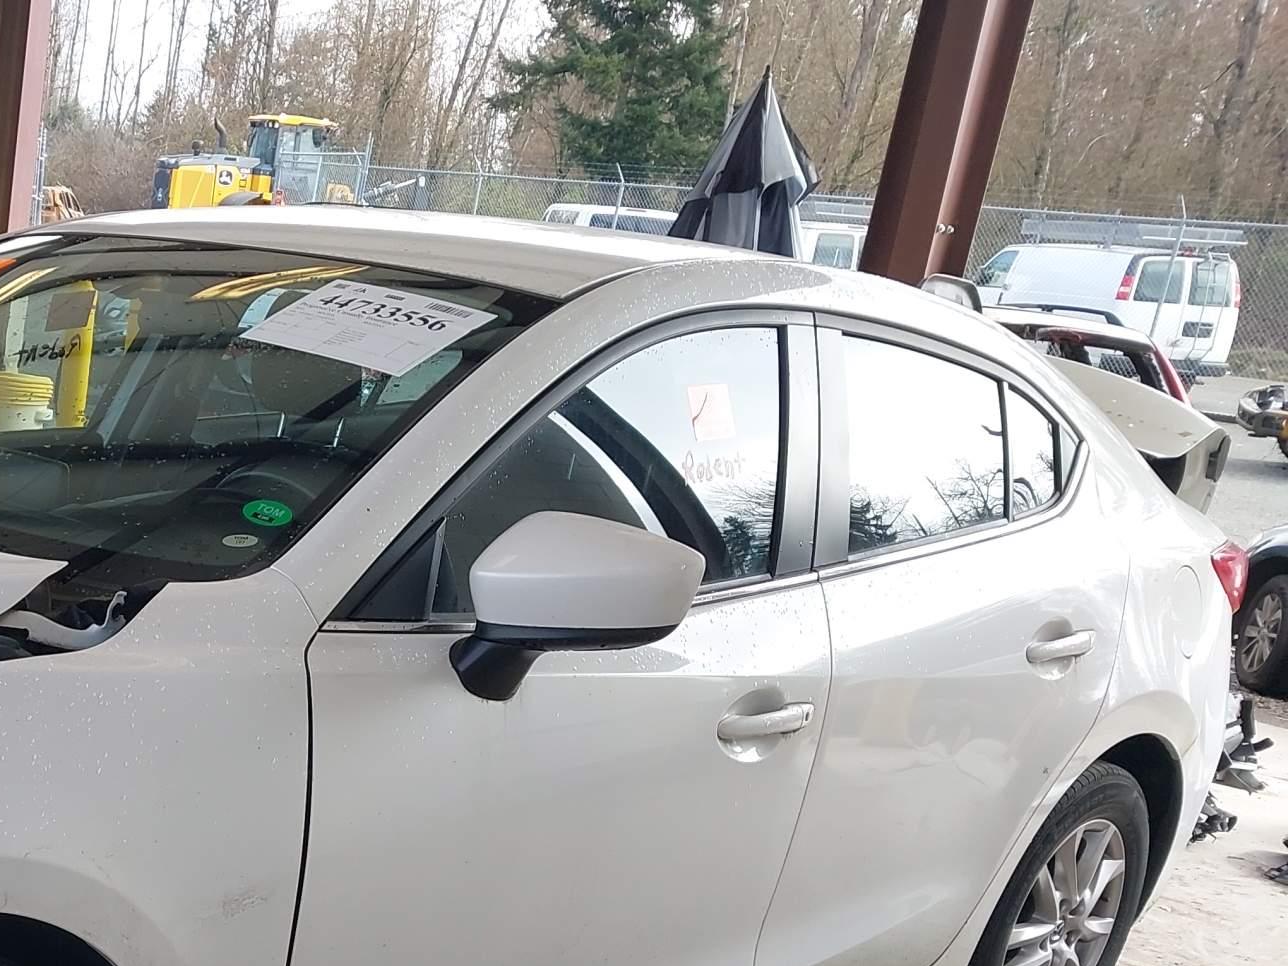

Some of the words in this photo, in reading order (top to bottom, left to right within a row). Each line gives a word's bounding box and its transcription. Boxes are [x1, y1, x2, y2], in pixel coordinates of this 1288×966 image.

[319, 294, 454, 331] 44733556
[682, 449, 746, 486] Rodent
[258, 504, 285, 517] TOM
